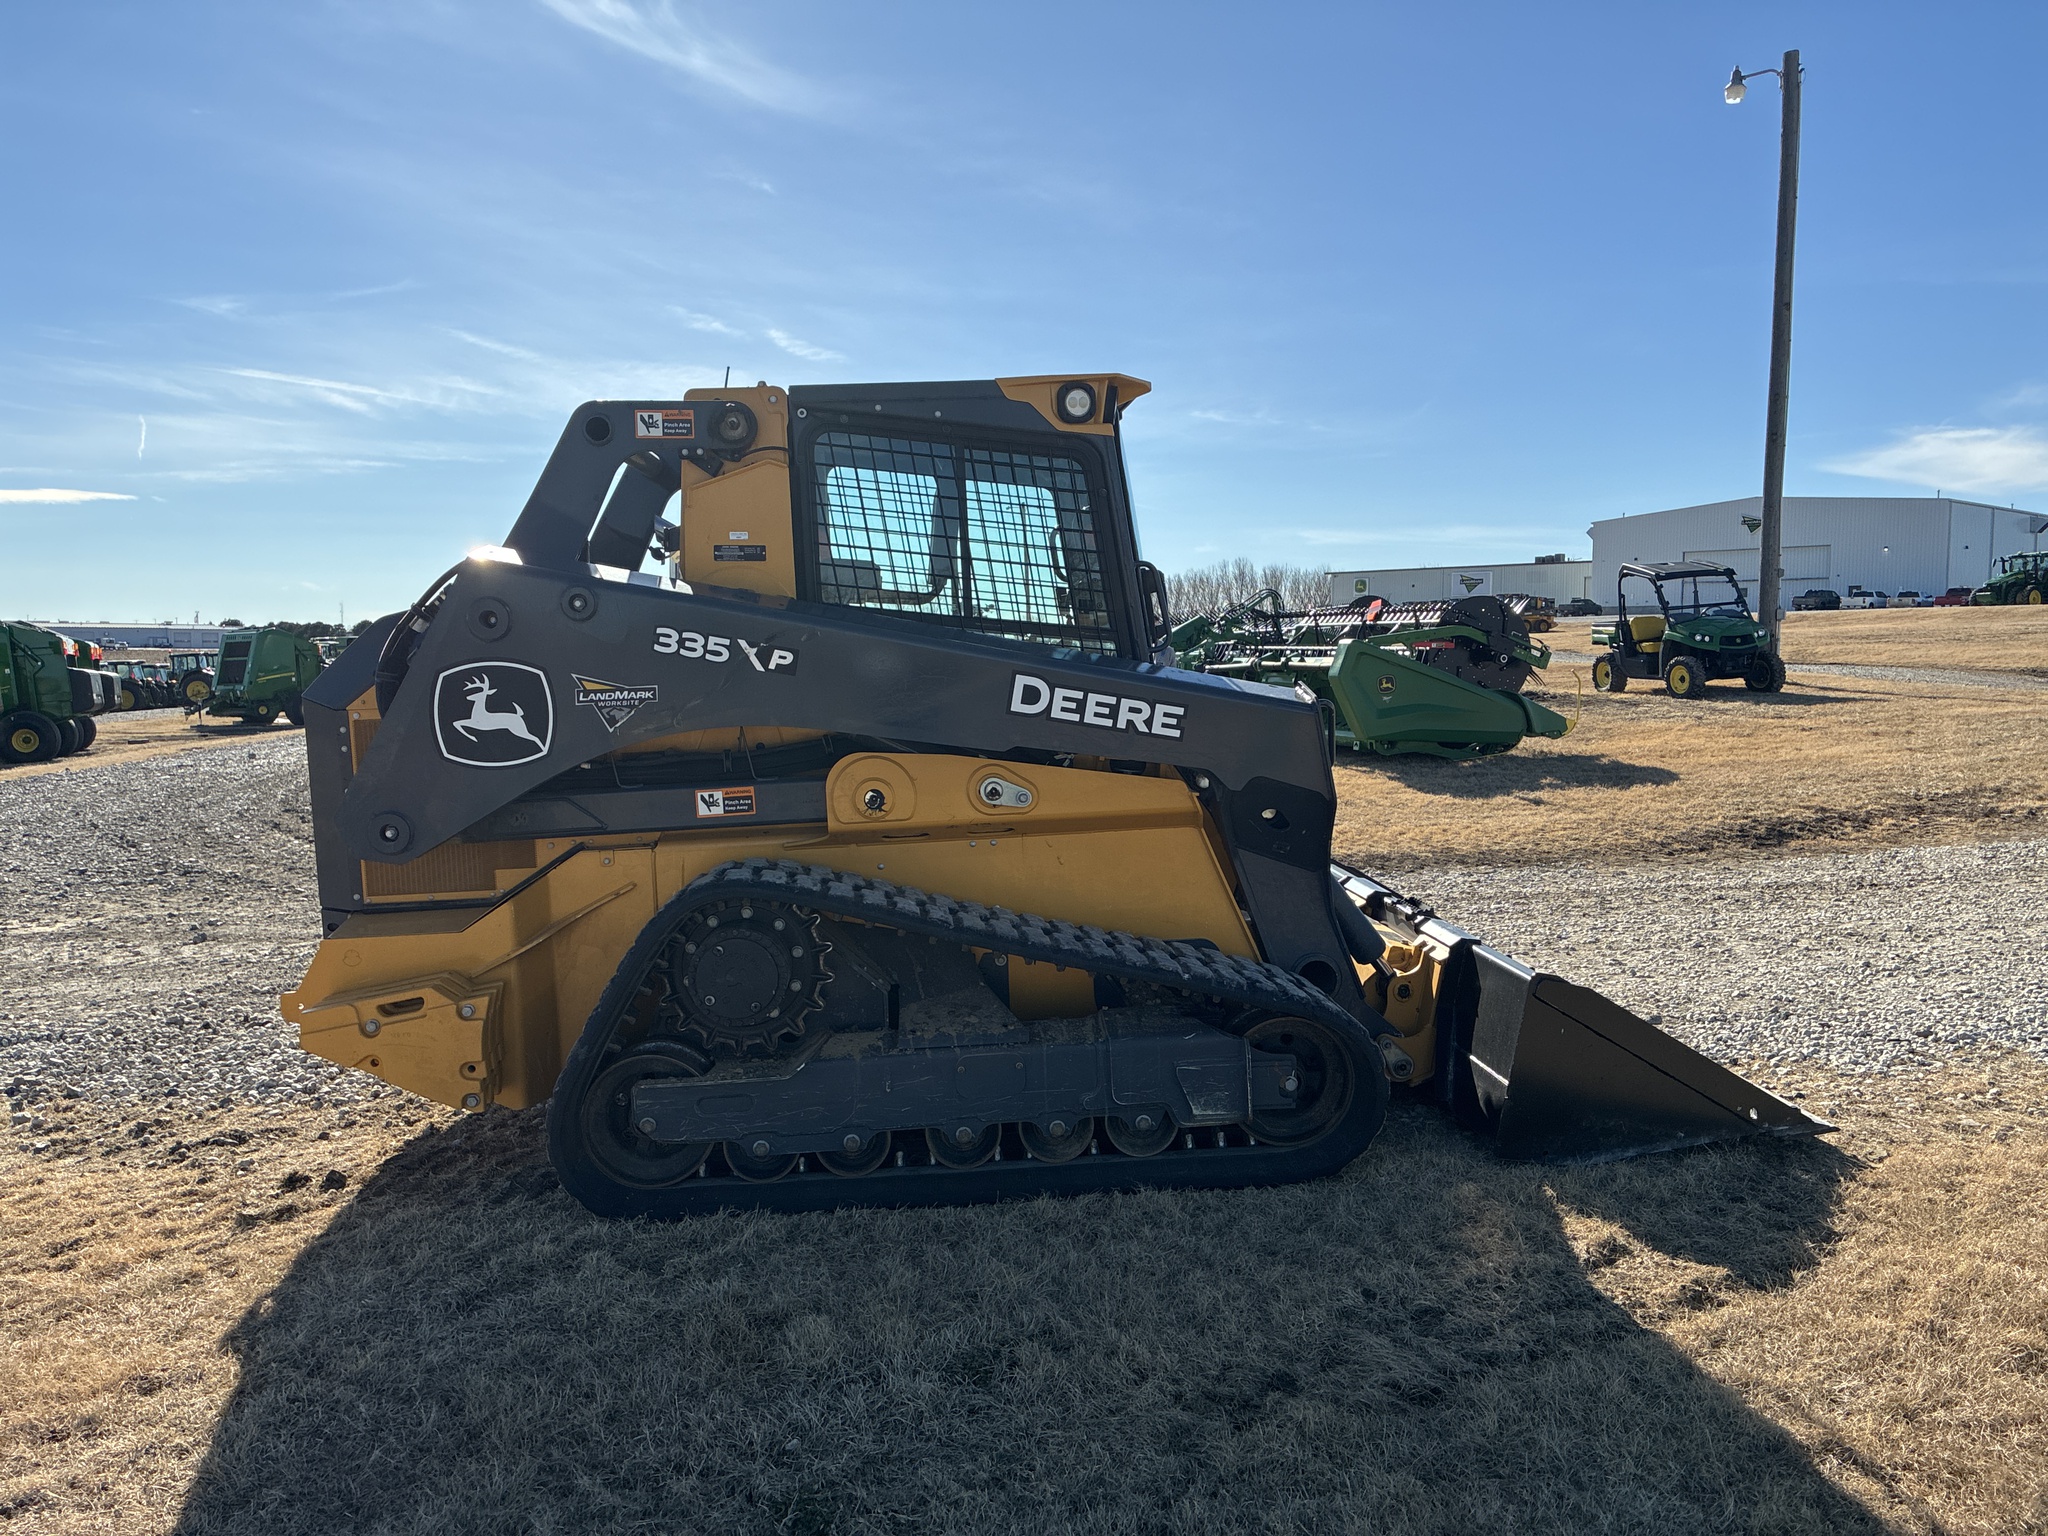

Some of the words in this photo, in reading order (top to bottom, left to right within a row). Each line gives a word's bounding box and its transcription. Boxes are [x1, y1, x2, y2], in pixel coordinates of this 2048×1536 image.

[653, 627, 731, 663] 335
[579, 690, 654, 701] LANDMARK
[1010, 674, 1185, 738] DEERE
